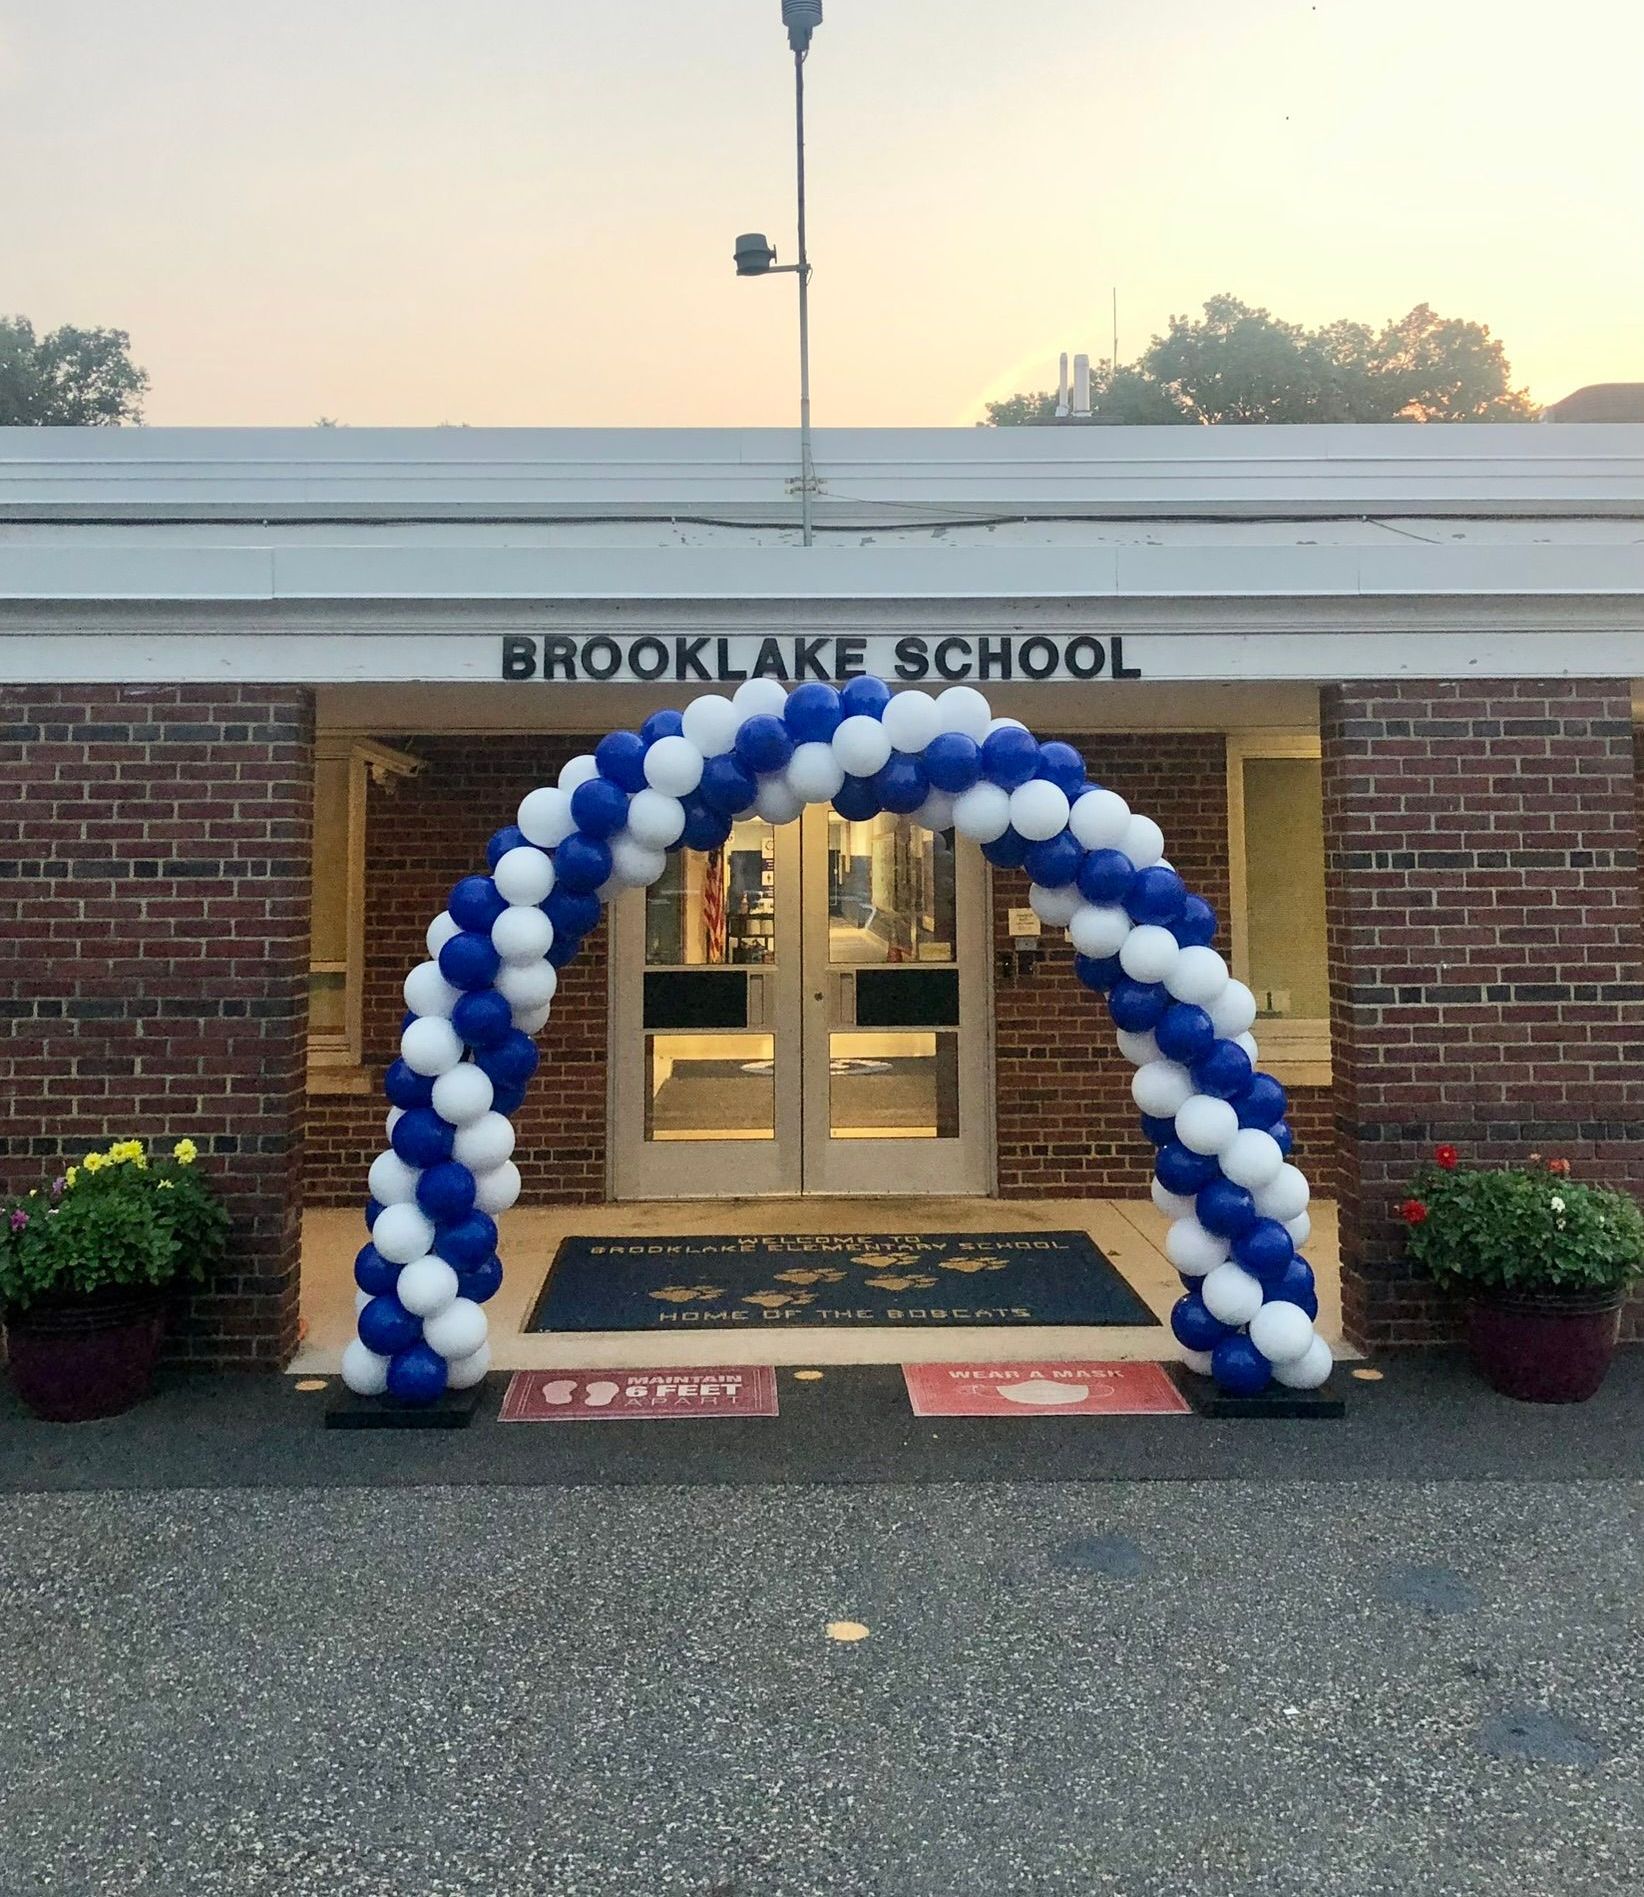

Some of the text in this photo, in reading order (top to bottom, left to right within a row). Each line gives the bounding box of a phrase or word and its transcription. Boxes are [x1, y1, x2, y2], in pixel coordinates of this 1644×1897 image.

[502, 635, 1142, 680] BROOKLAKE SCHOOL
[738, 1236, 872, 1244] WELCOME
[591, 1241, 1070, 1254] BROOKLAKE ELEMENTARY SCHOOL
[660, 1308, 1031, 1321] HOME OF THE BOBCATS
[627, 1375, 742, 1384] MAINTAIN
[949, 1370, 1125, 1378] WEAR A MASK
[625, 1384, 742, 1397] 6 FEET
[624, 1397, 739, 1406] APART
